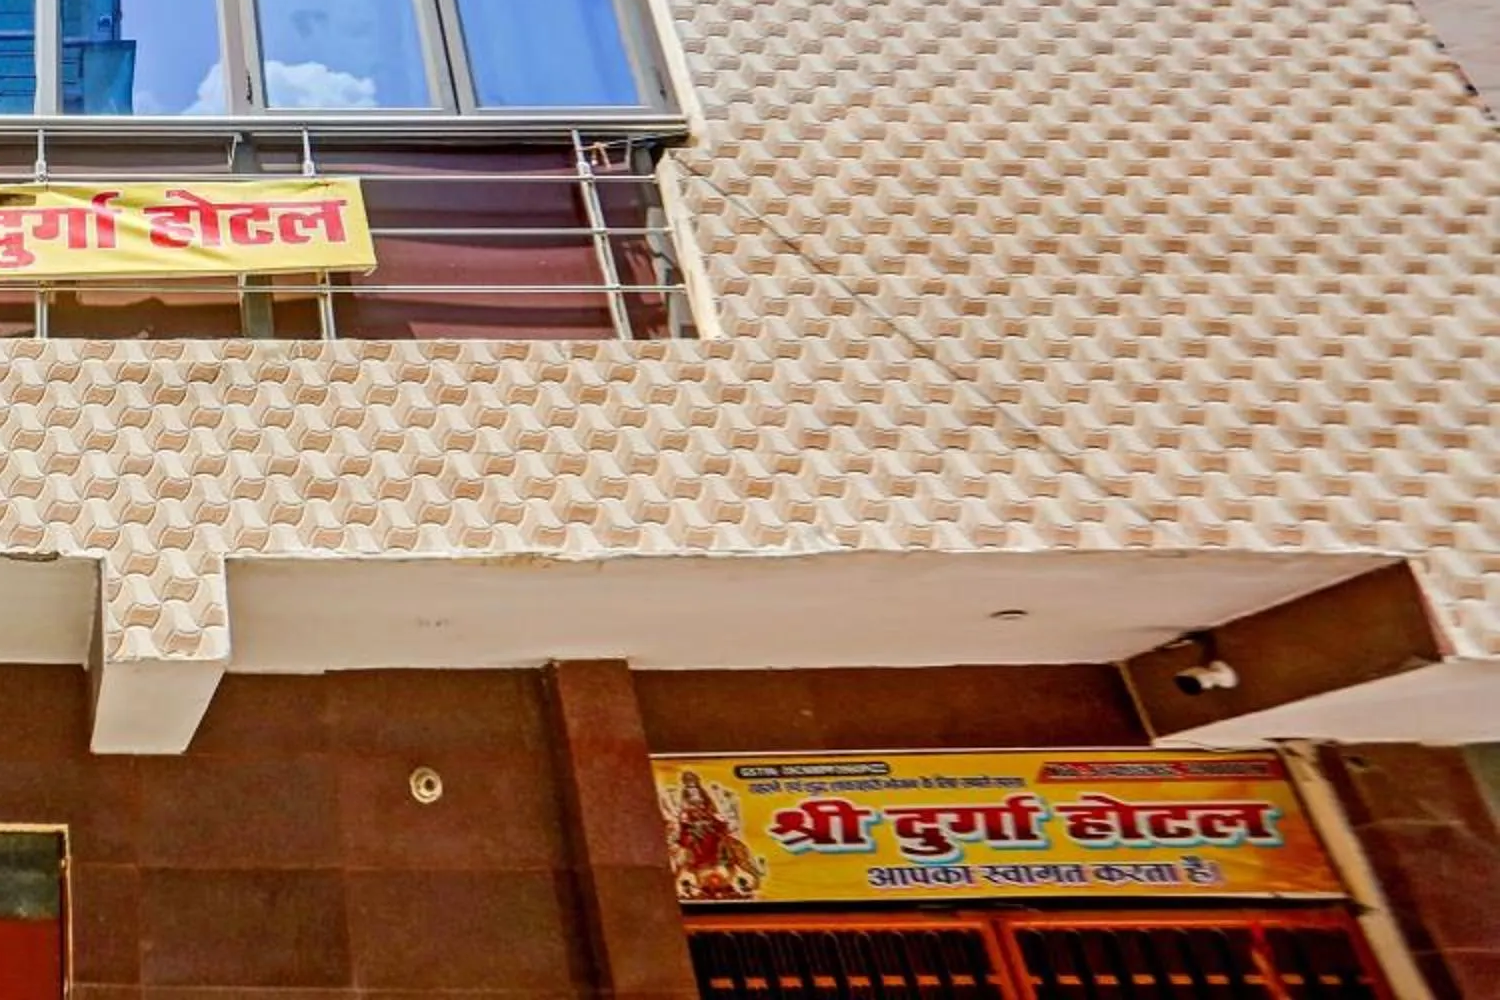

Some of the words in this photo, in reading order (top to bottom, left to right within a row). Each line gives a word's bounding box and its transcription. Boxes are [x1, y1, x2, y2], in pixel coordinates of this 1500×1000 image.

[145, 189, 348, 249] होटल
[770, 799, 874, 849] श्री
[883, 795, 1043, 860] दुर्गा
[1056, 795, 1276, 844] होटल
[867, 865, 973, 887] आपका
[981, 864, 1088, 884] स्वागत
[1094, 863, 1182, 883] करता
